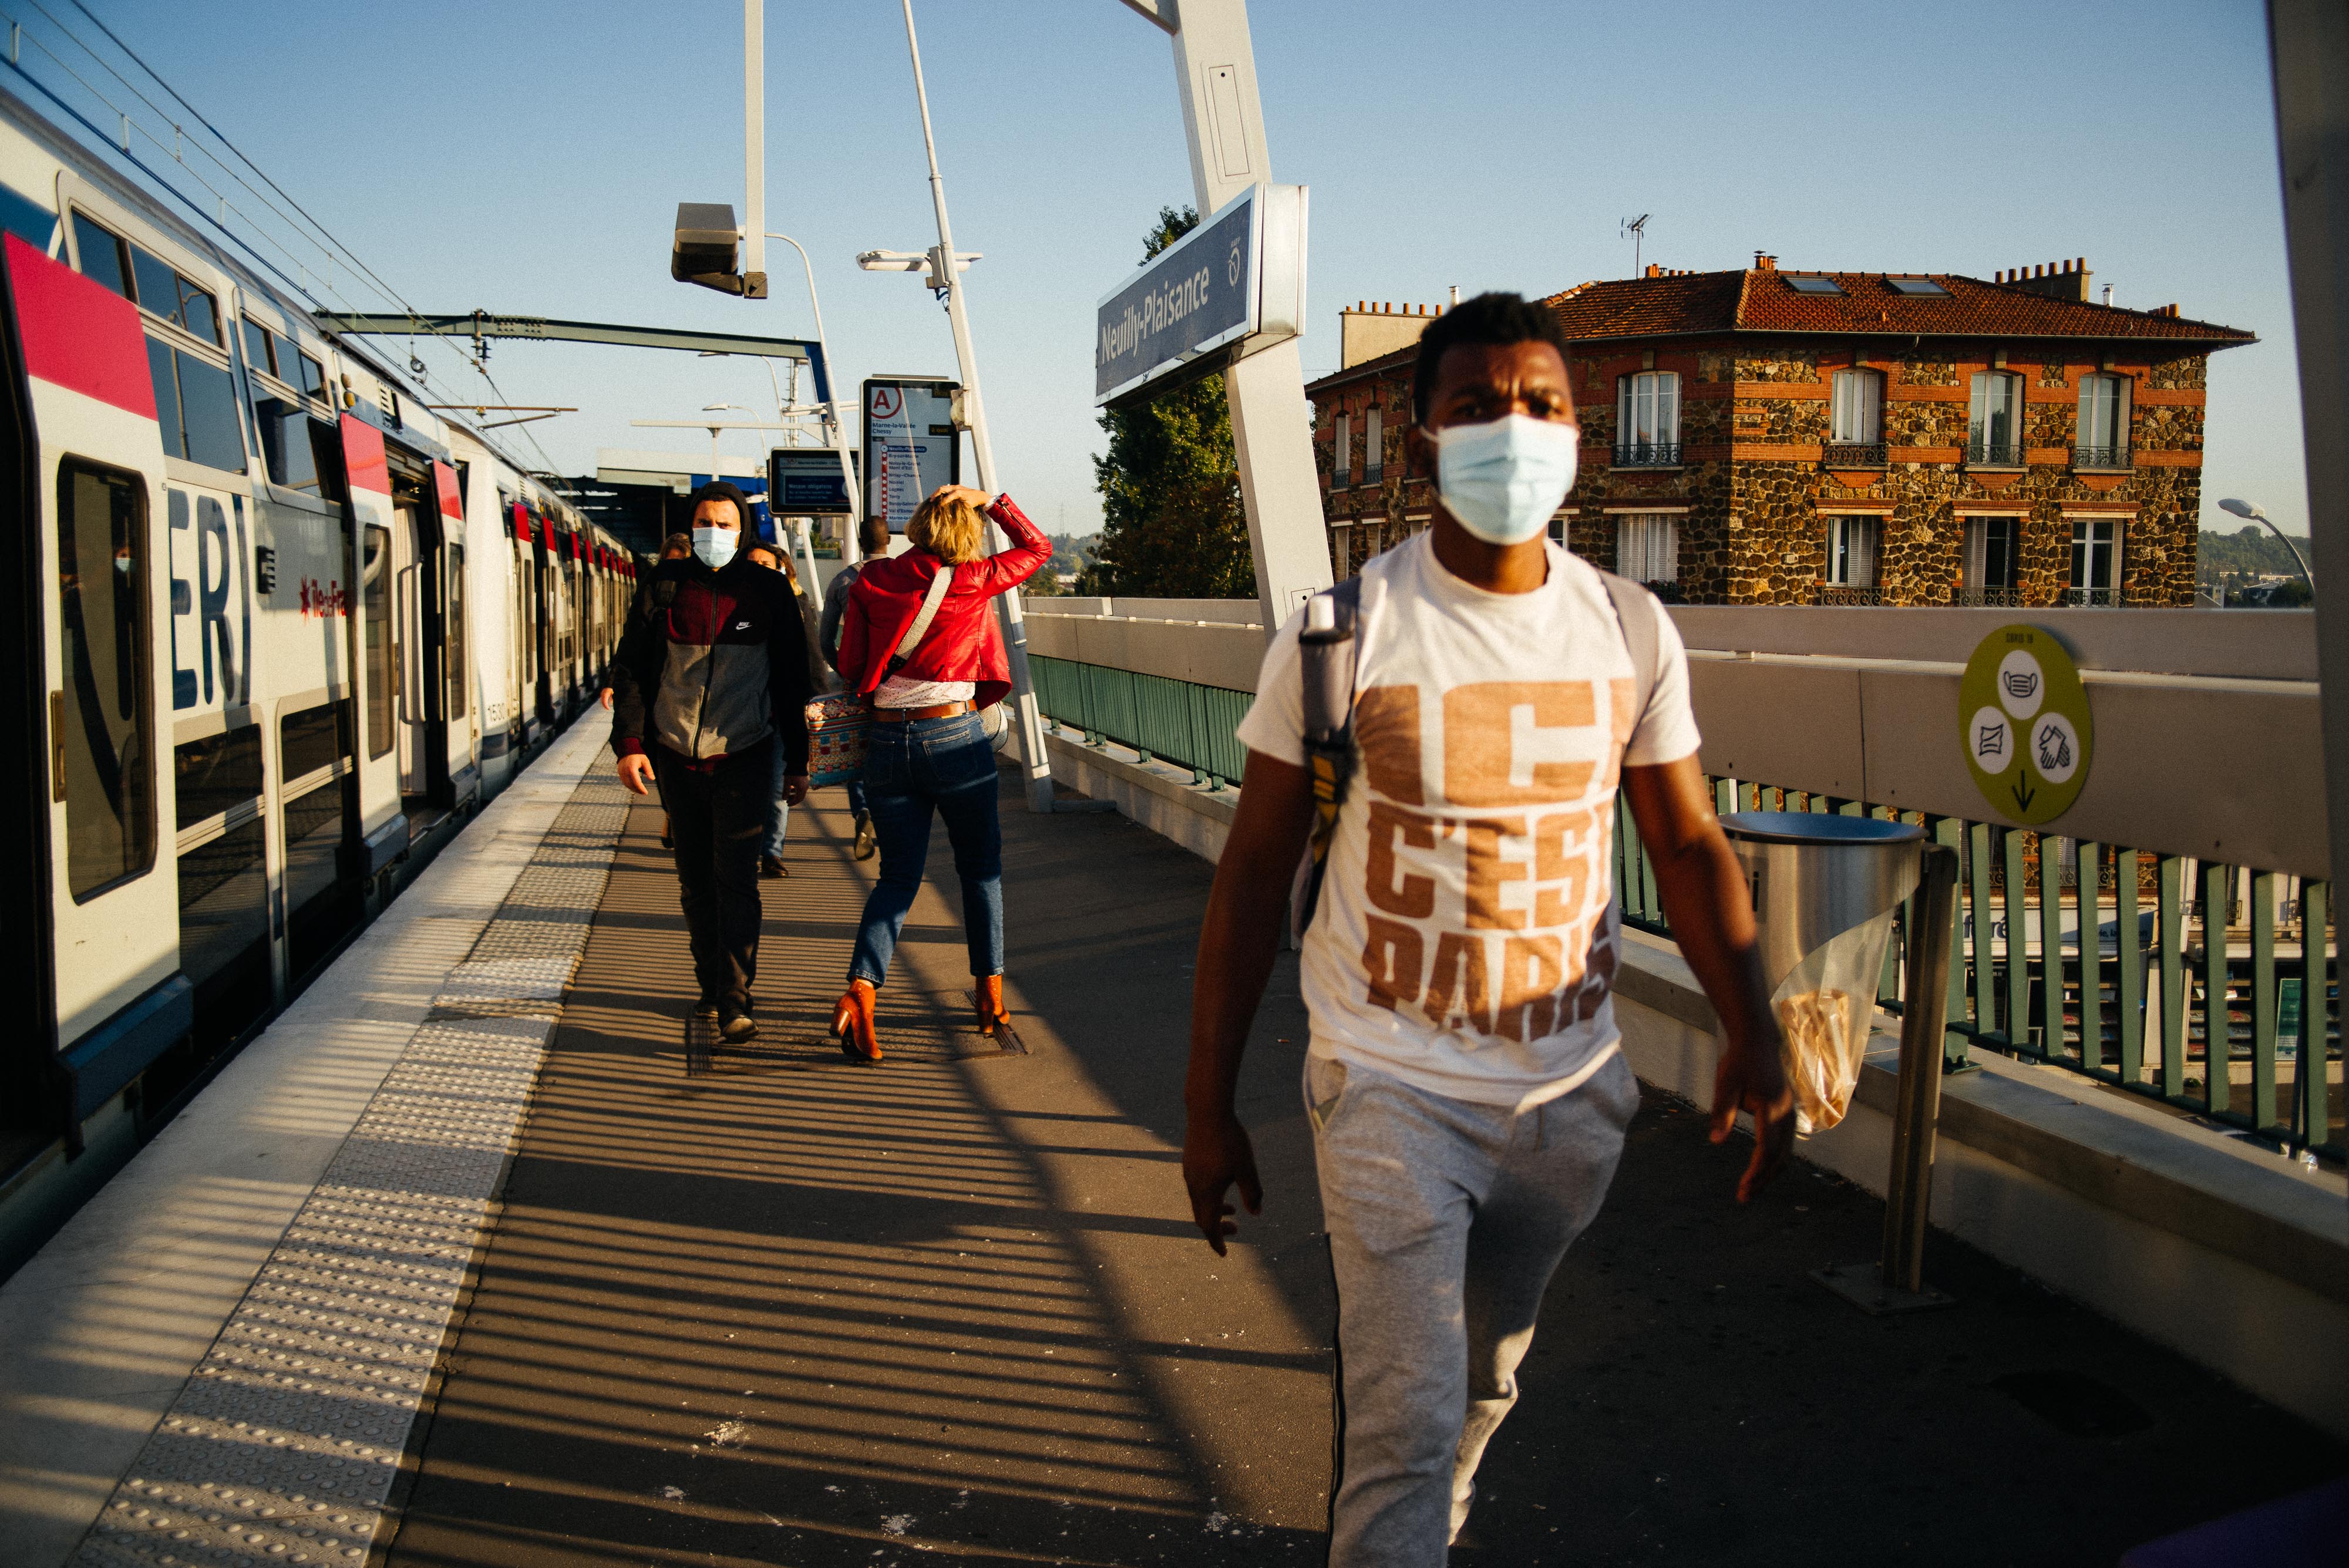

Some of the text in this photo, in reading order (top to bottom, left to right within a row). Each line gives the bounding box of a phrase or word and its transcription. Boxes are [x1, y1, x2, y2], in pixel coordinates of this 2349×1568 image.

[1102, 266, 1210, 365] Neuilly-Plaisance
[873, 389, 891, 409] A
[1354, 678, 1637, 808] ICI
